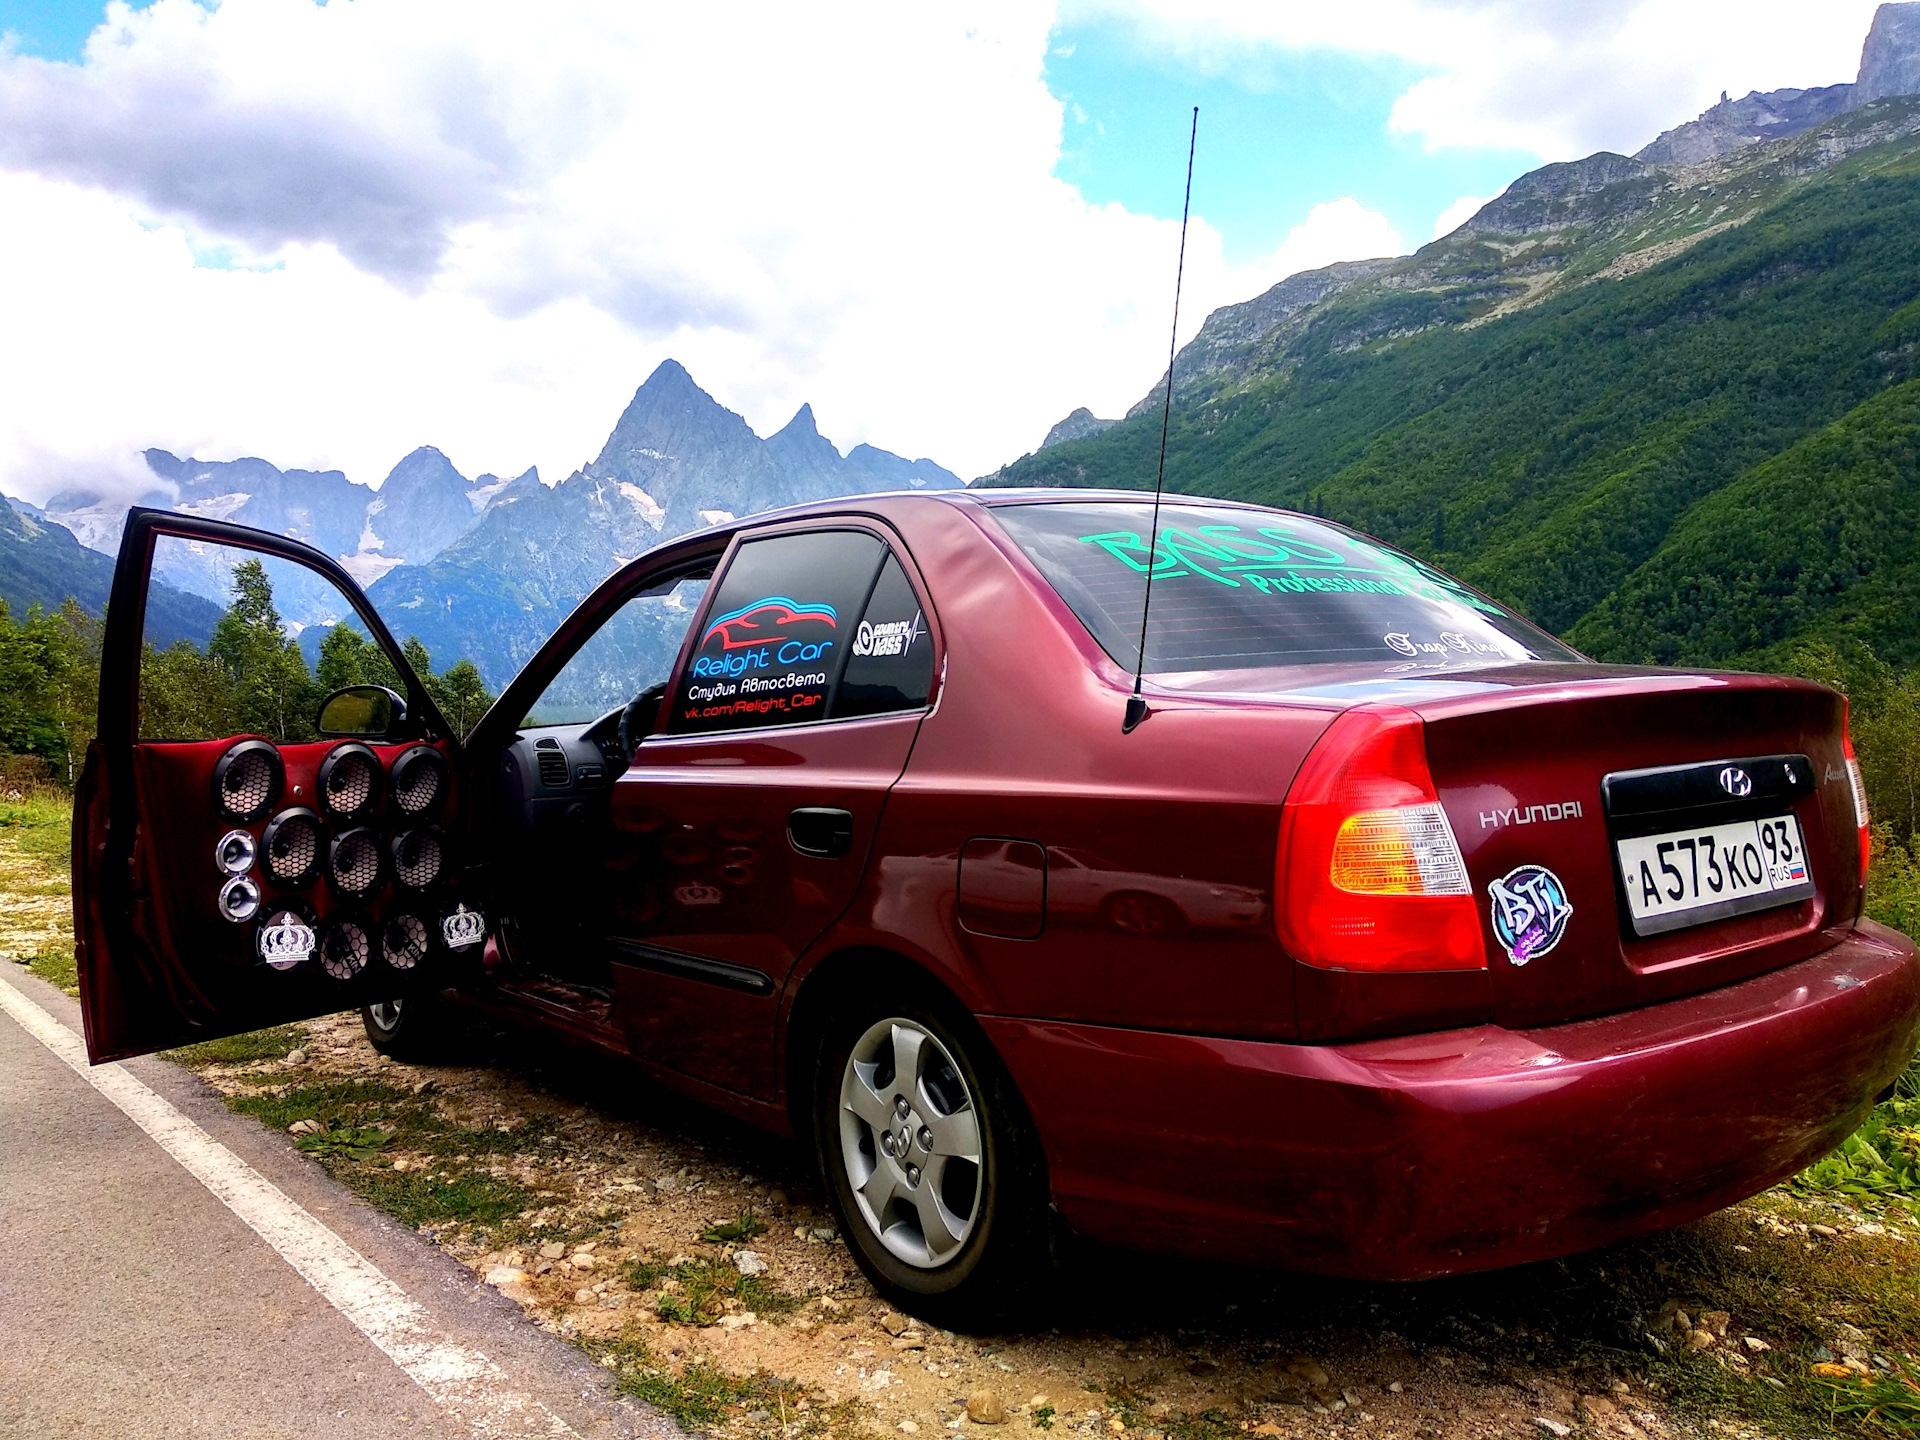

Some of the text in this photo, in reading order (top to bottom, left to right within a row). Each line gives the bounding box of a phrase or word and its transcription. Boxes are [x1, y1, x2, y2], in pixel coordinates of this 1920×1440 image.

[1079, 525, 1345, 588] BASS
[1242, 571, 1410, 597] Professional
[1383, 632, 1449, 658] Trap
[693, 641, 833, 678] Relight Car
[688, 682, 736, 701] Студия
[685, 694, 822, 719] vk.com/Relight_Car
[1479, 801, 1583, 829] HYUNDAI
[1761, 821, 1793, 865] 93
[1769, 865, 1791, 882] RUS
